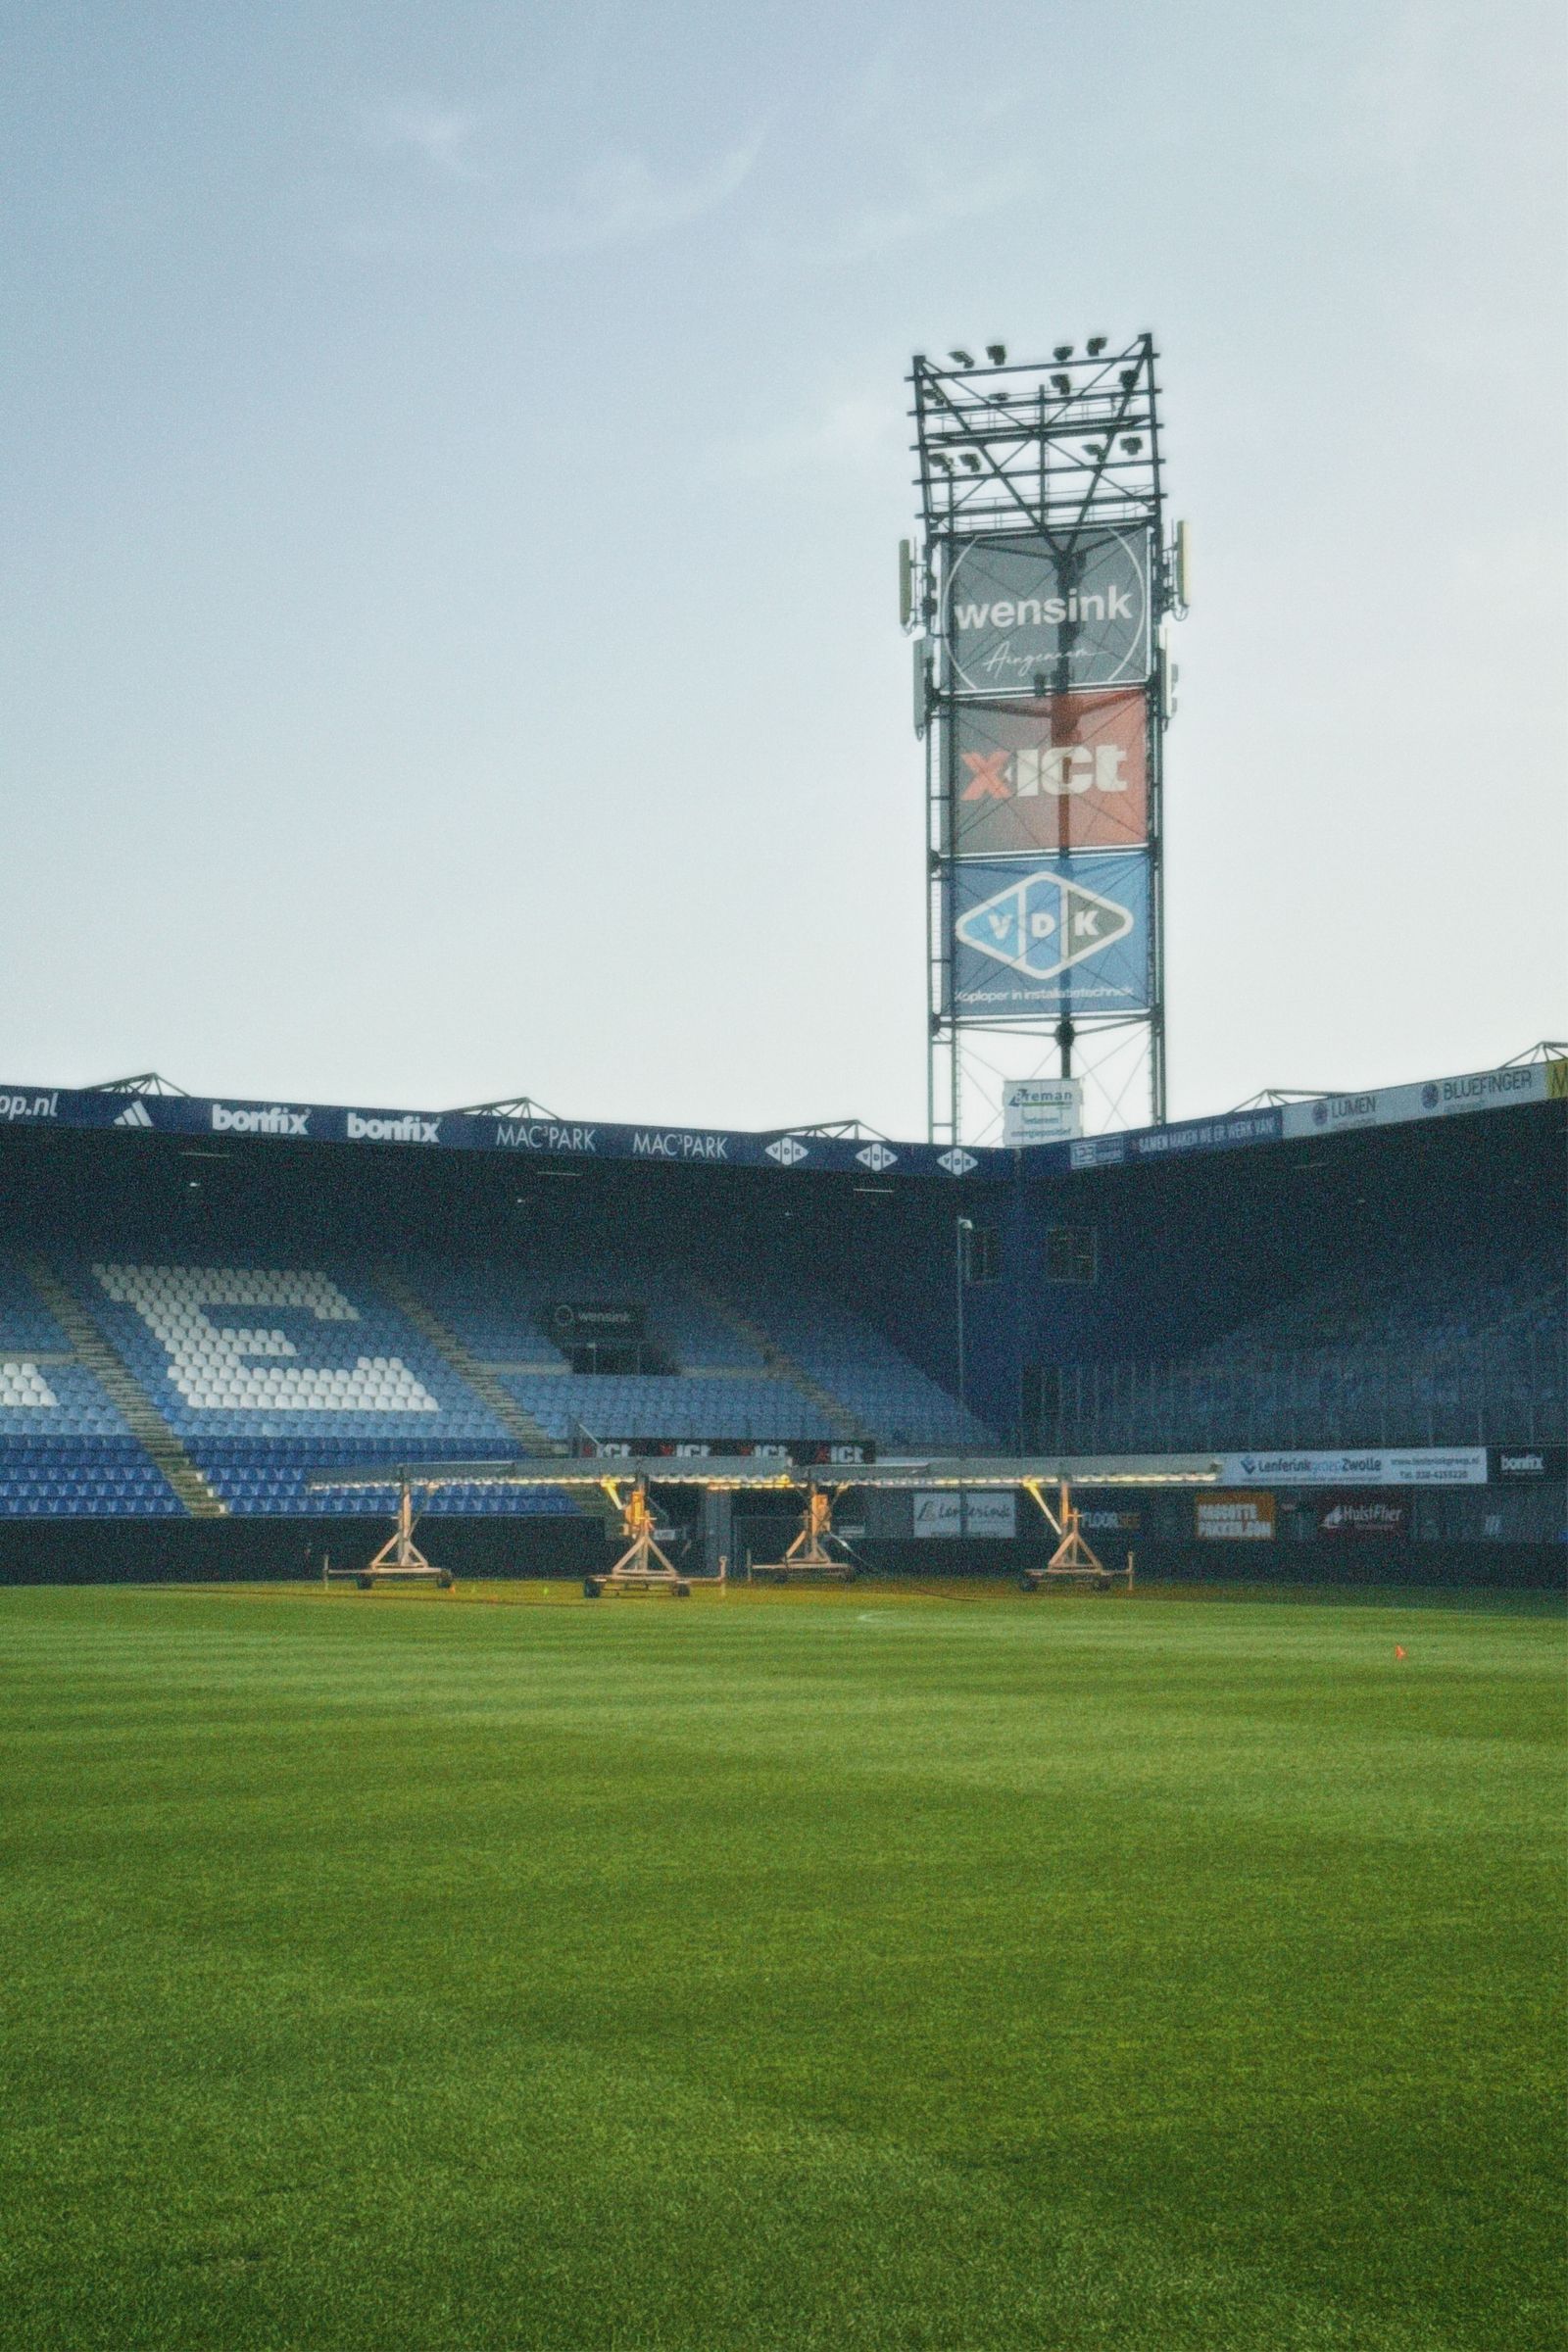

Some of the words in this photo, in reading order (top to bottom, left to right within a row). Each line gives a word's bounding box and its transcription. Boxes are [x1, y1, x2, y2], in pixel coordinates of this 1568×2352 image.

[954, 585, 1133, 630] wensink
[1011, 990, 1023, 1001] in
[1444, 1070, 1532, 1101] BLUEFINGER
[212, 1103, 309, 1135] bonfix
[1331, 1096, 1377, 1118] LUMEN
[347, 1112, 440, 1143] bonfix
[1342, 1457, 1383, 1472] Zwolle
